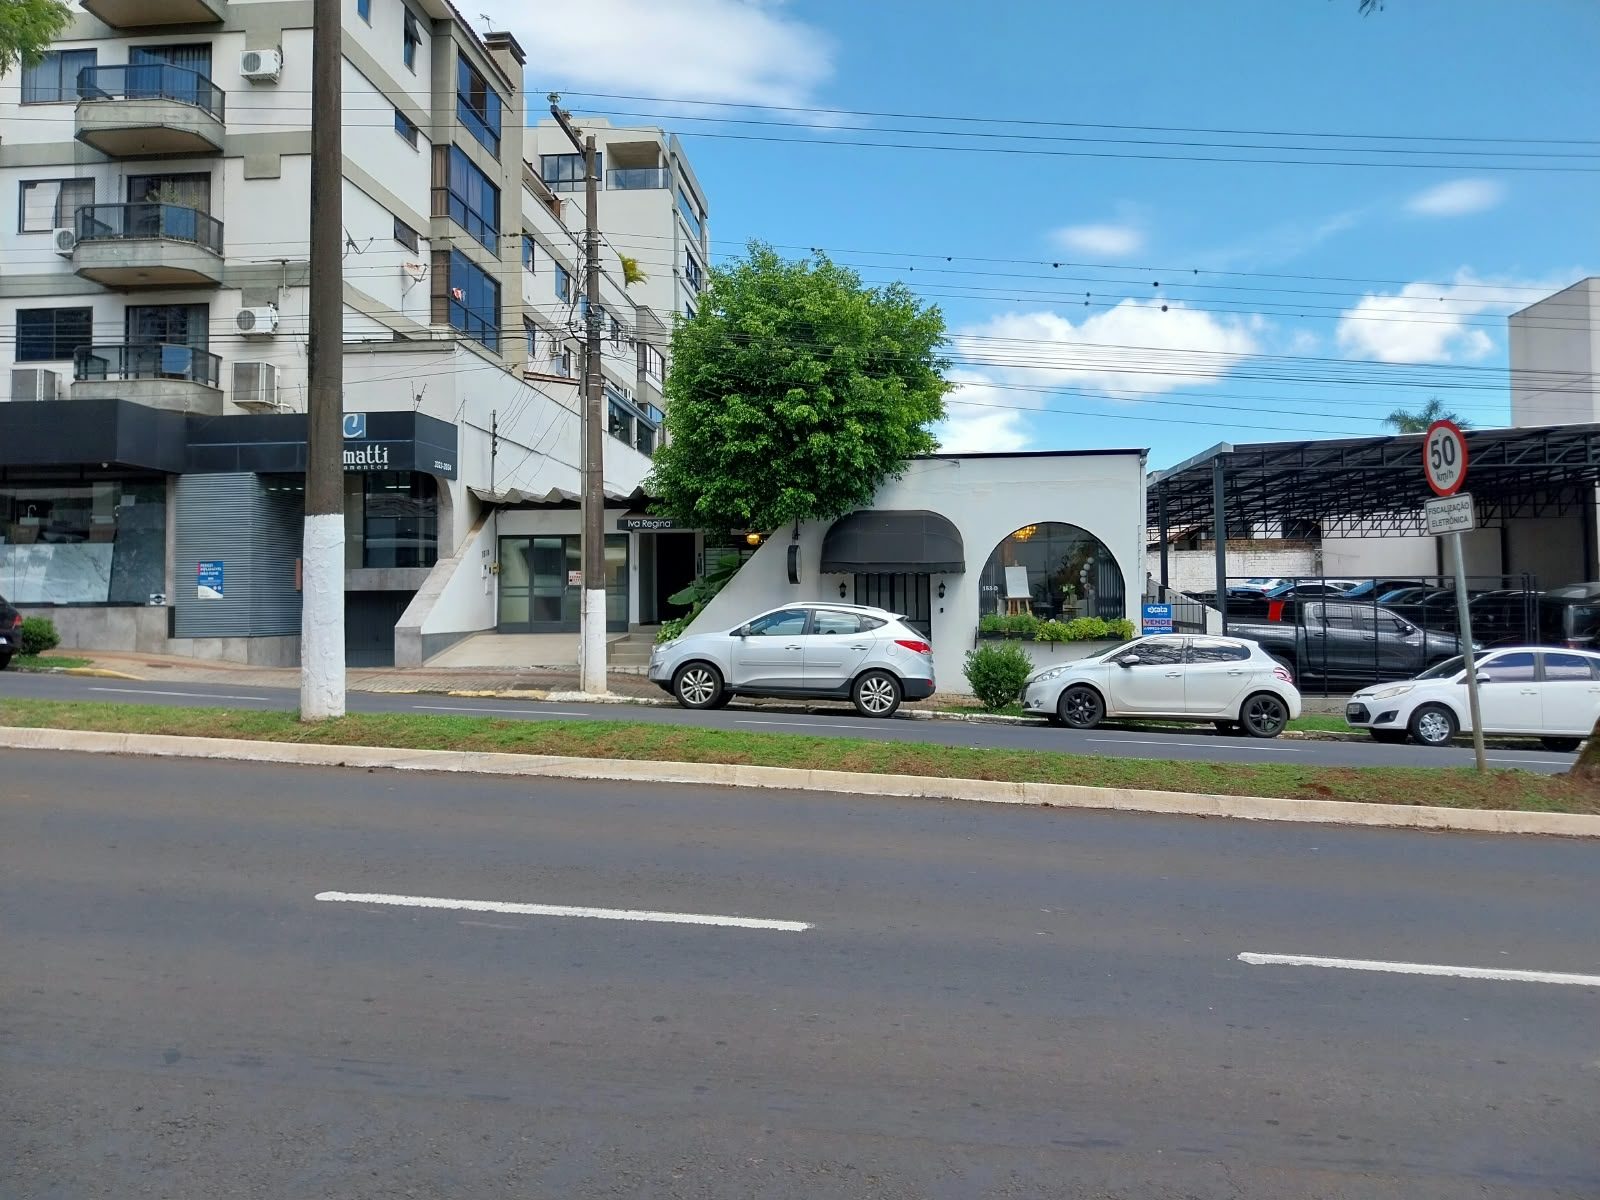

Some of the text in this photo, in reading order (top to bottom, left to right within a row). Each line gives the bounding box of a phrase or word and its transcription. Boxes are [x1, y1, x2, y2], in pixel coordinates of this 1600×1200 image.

[343, 444, 389, 464] matti
[1430, 435, 1455, 470] 50
[1436, 469, 1454, 482] km/h
[1428, 501, 1469, 515] FISCALIZAÇÃO
[628, 519, 671, 529] Iva Regina
[1431, 515, 1469, 528] ELETRÔNICA
[1144, 618, 1172, 626] VENDE
